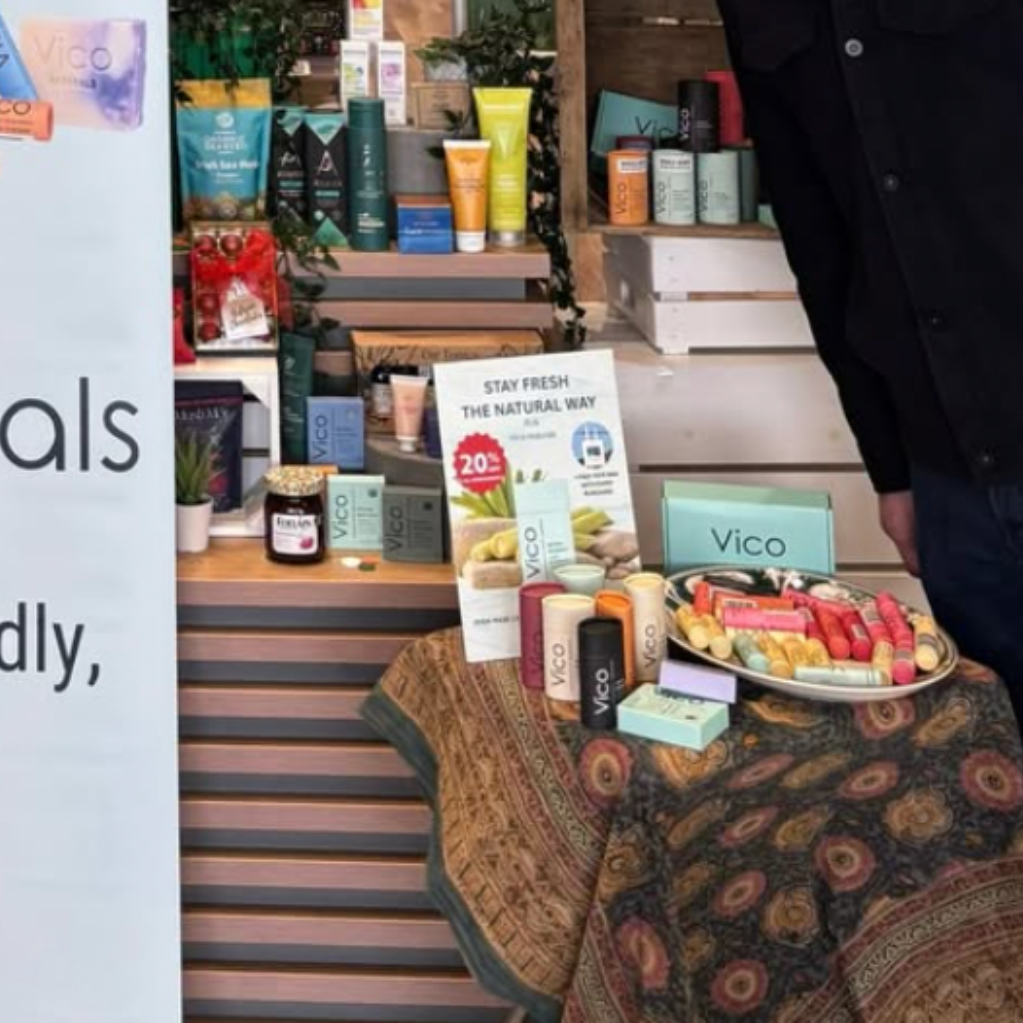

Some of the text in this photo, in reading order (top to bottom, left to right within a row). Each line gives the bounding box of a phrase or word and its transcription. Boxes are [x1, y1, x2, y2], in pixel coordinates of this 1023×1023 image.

[33, 32, 113, 72] Vico
[635, 116, 673, 140] Vic
[656, 181, 667, 216] Vico
[483, 375, 569, 395] STAY FRESH
[461, 395, 596, 419] THE NATURAL WAY
[313, 415, 329, 460] Vico
[332, 495, 348, 539] Vico
[385, 505, 403, 552] Vico
[524, 526, 540, 579] Vico
[711, 528, 787, 558] Vico
[551, 643, 566, 686] Vico
[644, 624, 657, 669] Vico
[592, 668, 610, 716] Vico
